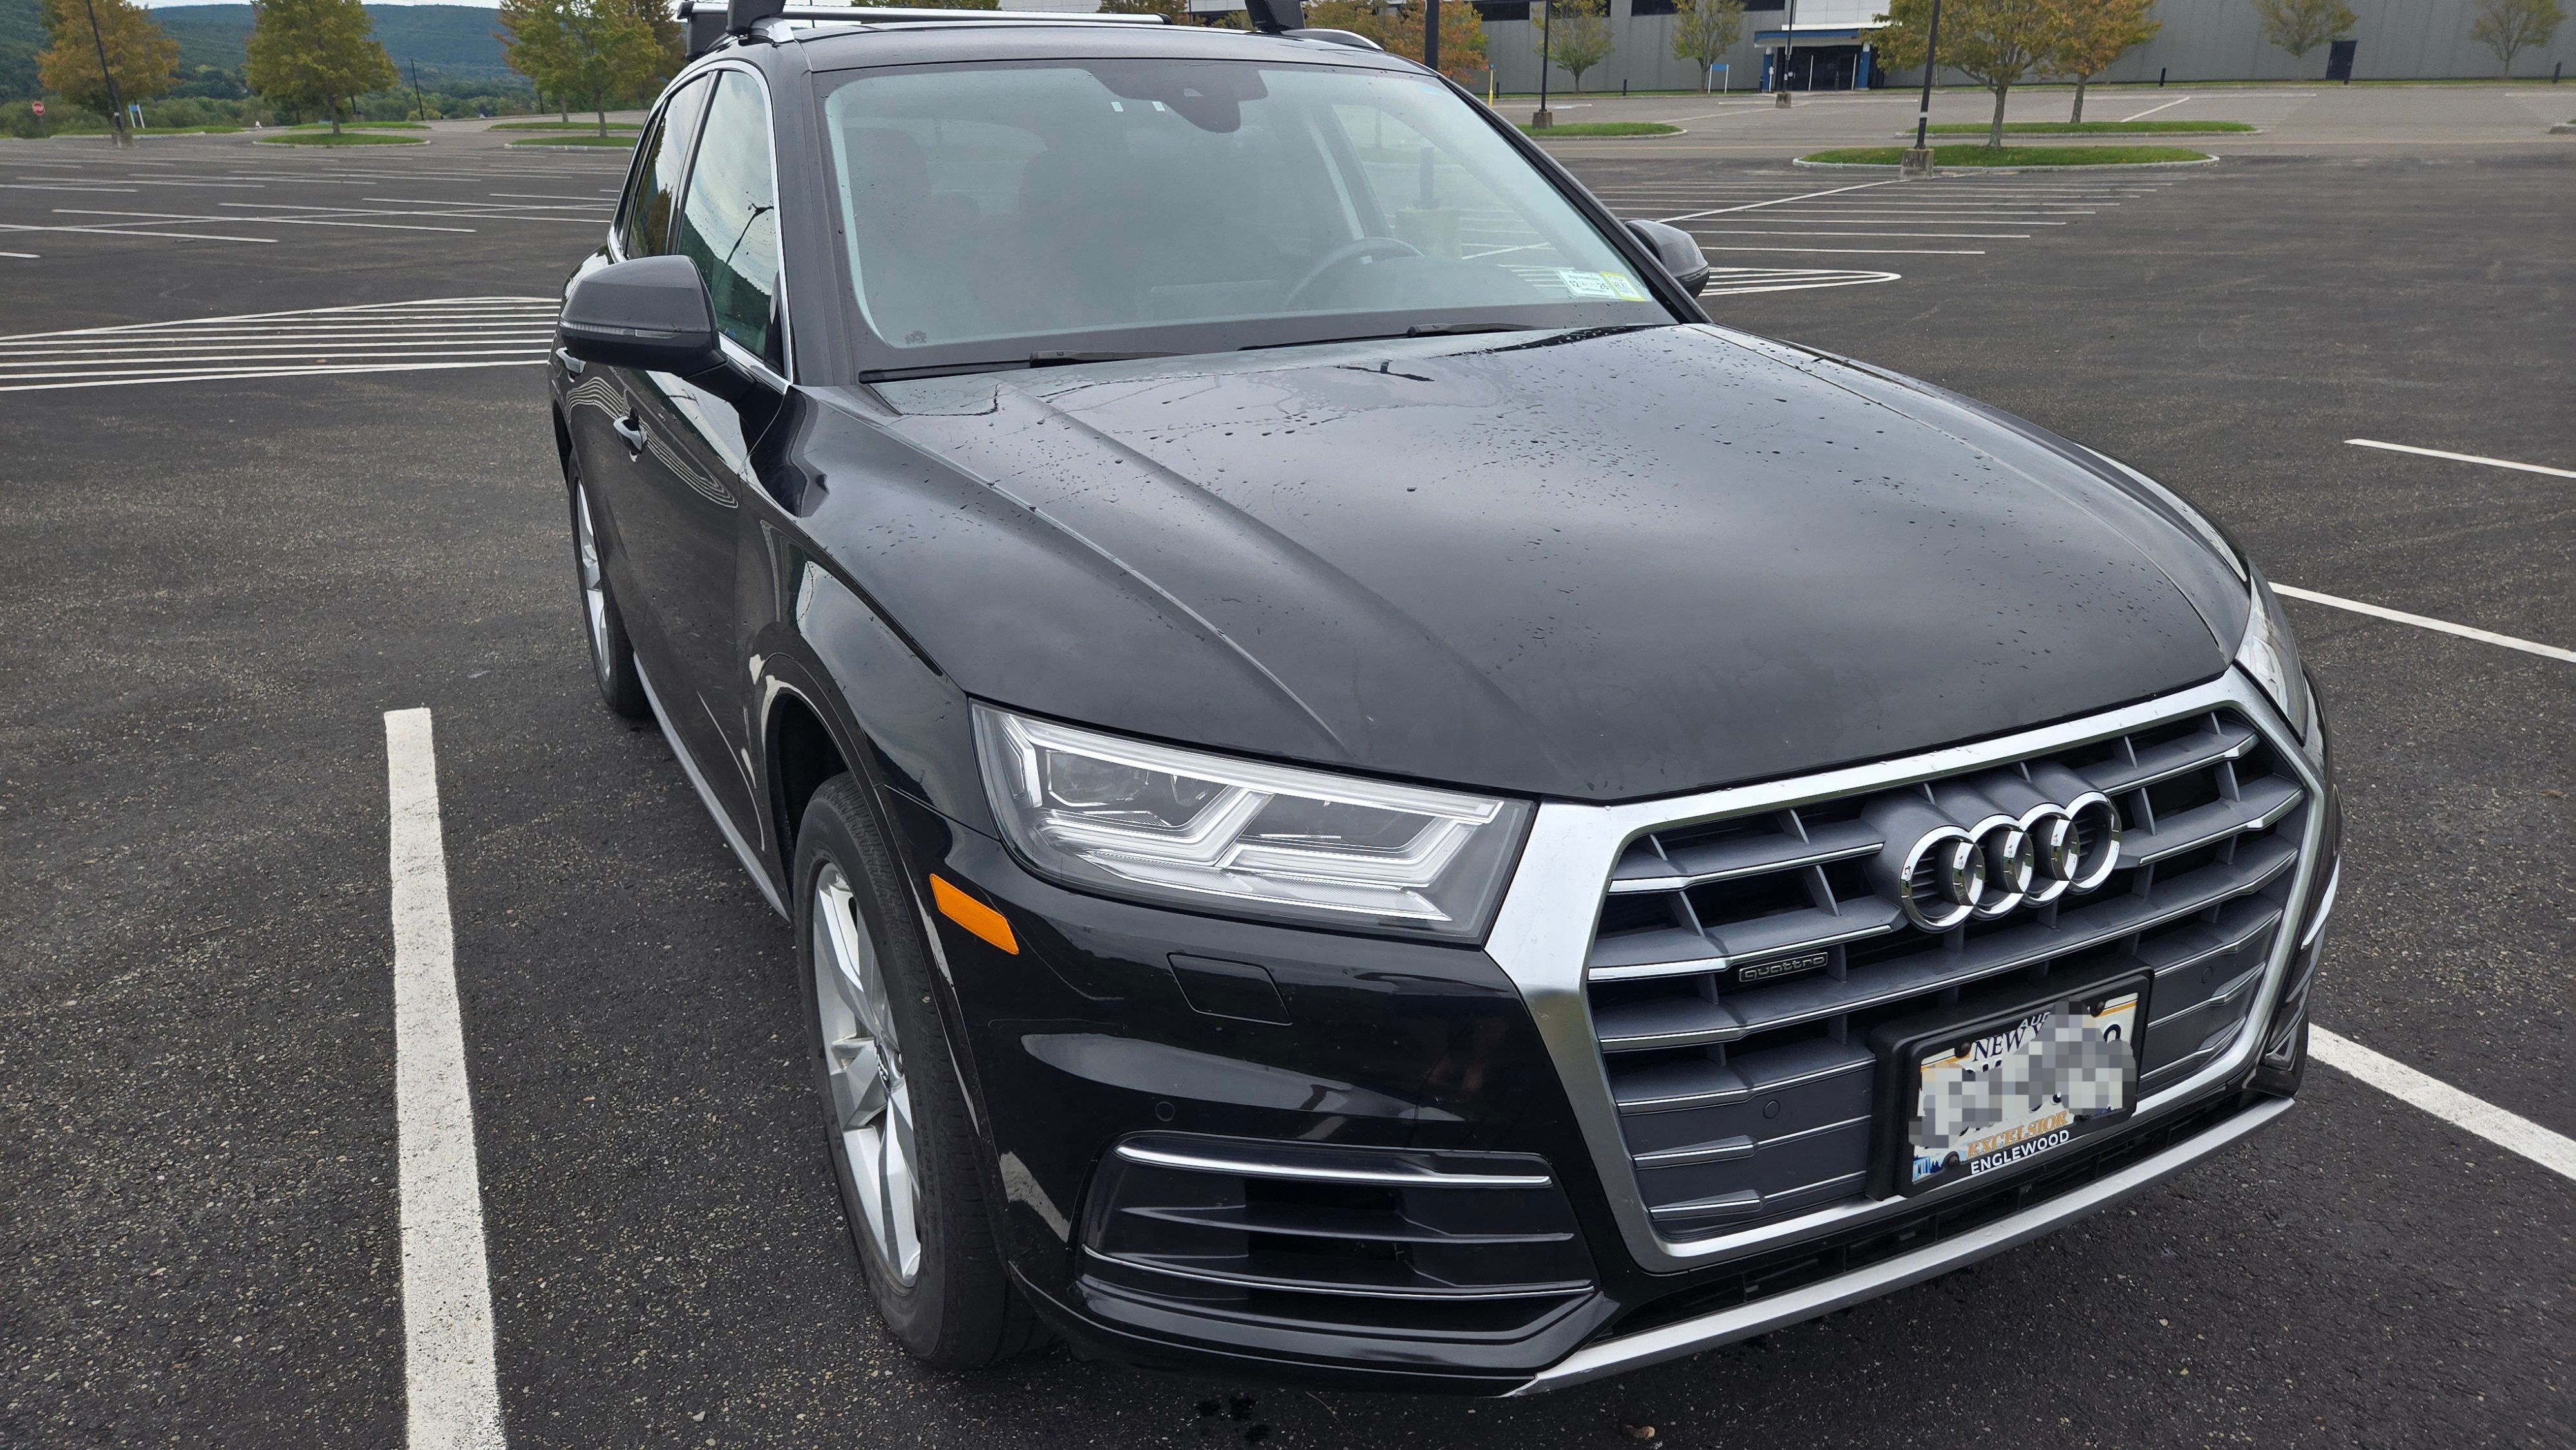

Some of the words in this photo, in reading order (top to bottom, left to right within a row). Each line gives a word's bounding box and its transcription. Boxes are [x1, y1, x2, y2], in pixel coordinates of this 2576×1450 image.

[1745, 956, 1824, 979] quattro
[1972, 1026, 2027, 1062] NEW
[1967, 1110, 2068, 1160] EXCELSIOR
[1971, 1129, 2069, 1174] ENGLEWOOD
